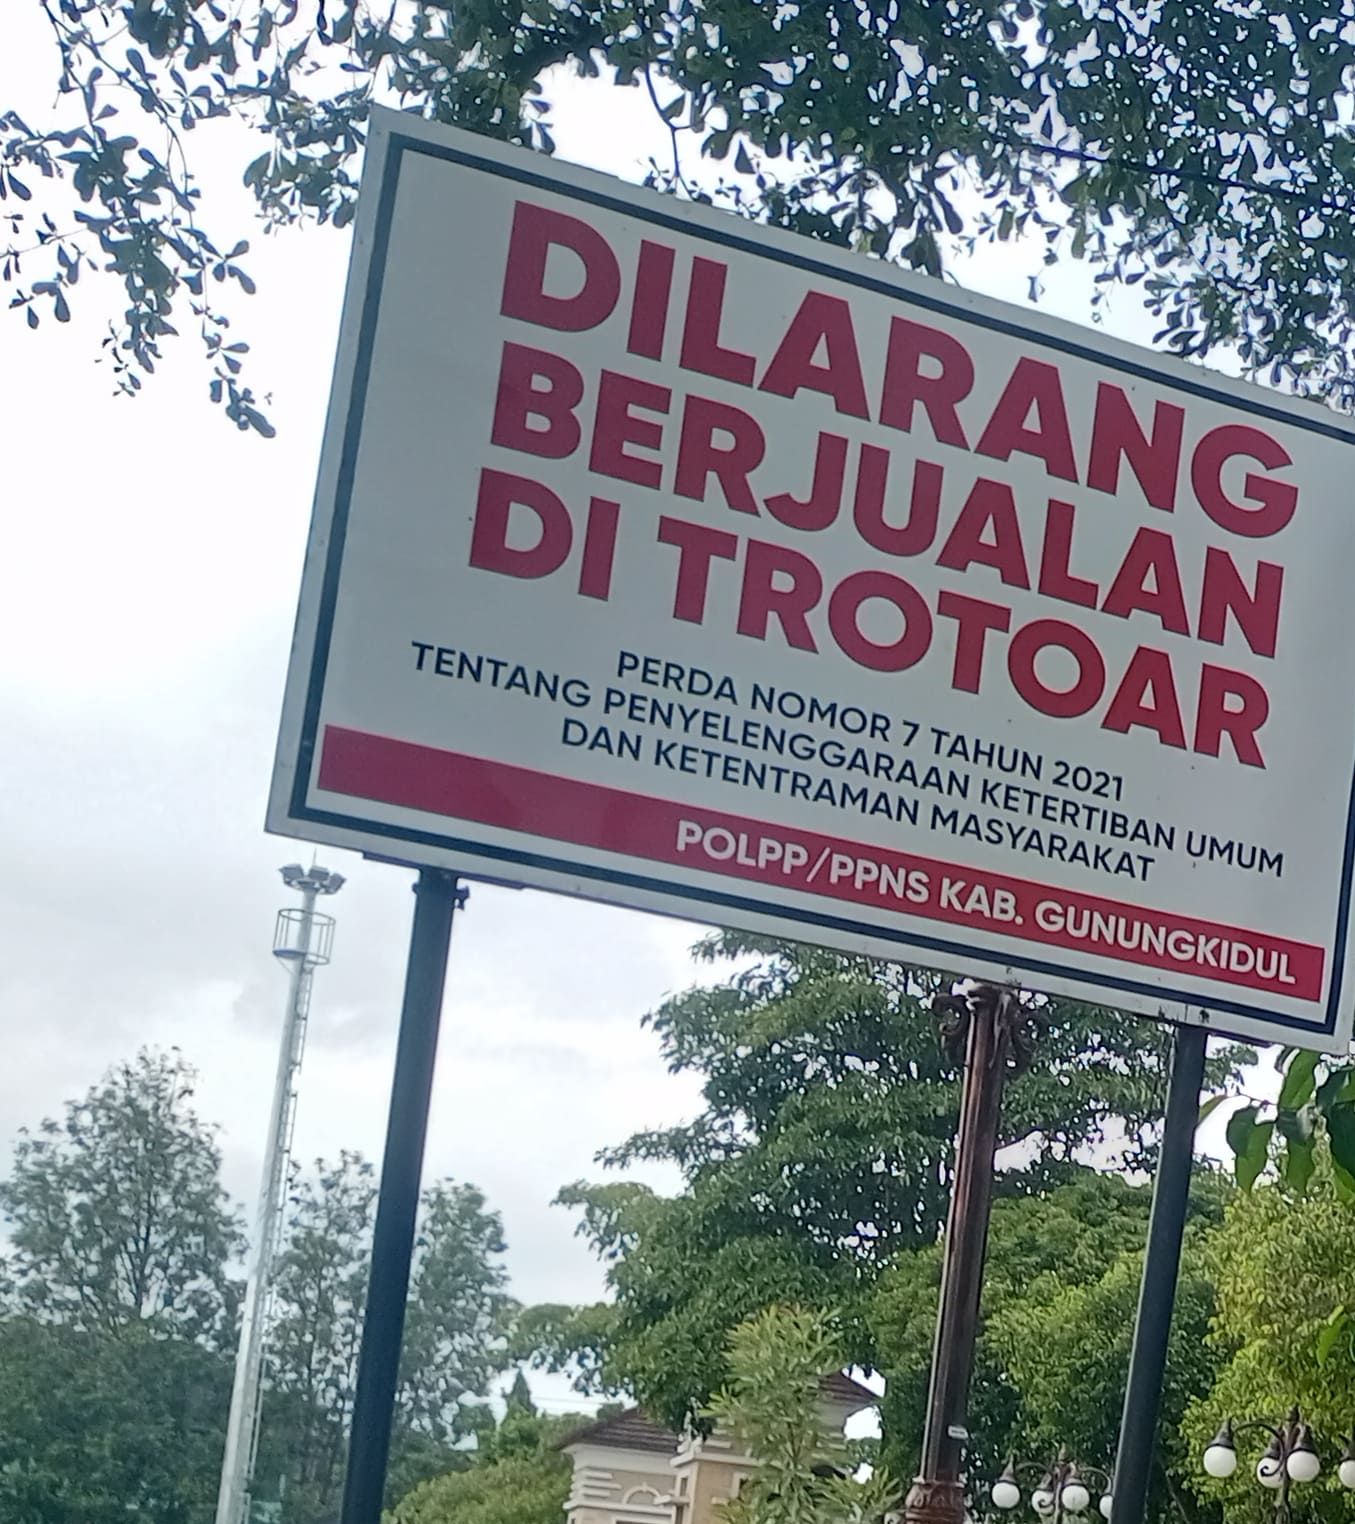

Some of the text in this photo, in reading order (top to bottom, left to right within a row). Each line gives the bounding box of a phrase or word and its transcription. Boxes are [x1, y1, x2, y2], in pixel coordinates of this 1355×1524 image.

[499, 199, 1298, 538] DILARANG
[468, 466, 1270, 769] DI TROTOAR
[489, 340, 1285, 658] BERJUALAN
[411, 640, 1284, 878] TENTANG PENYELENGGARAAN KETERTIBAN UMUM
[561, 717, 1156, 882] DAN KETENTRAMAN MASYARAKAT
[616, 650, 1124, 802] PERDA NOMOR 7 TAHUN 2021
[676, 819, 1296, 985] POLPP/PPNS KAB. GUNUNGKIDUL
